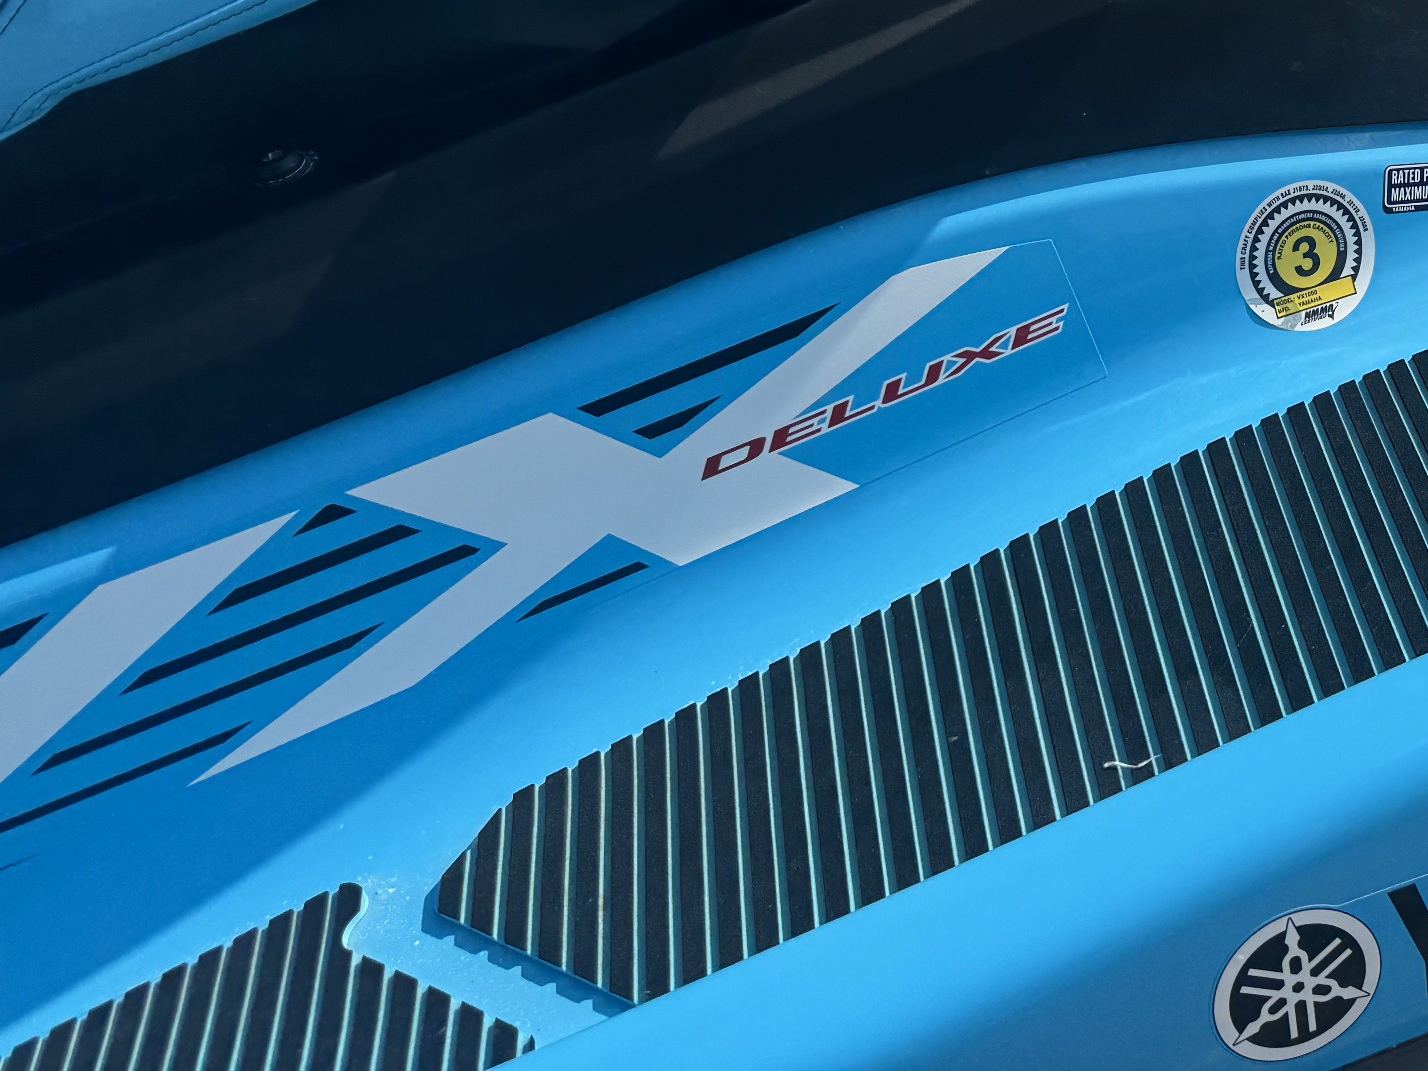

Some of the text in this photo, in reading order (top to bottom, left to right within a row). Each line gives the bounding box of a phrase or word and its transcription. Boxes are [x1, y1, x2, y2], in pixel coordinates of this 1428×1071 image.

[1391, 169, 1421, 185] RATED
[1246, 206, 1268, 235] COMPLIES
[1266, 195, 1281, 209] WITH
[1280, 188, 1292, 199] SAE
[1277, 239, 1288, 261] RATED
[1312, 223, 1335, 244] CAPACITY
[1292, 235, 1321, 278] 3
[1297, 295, 1323, 308] YAMAHA
[701, 302, 1069, 482] DELUXE
